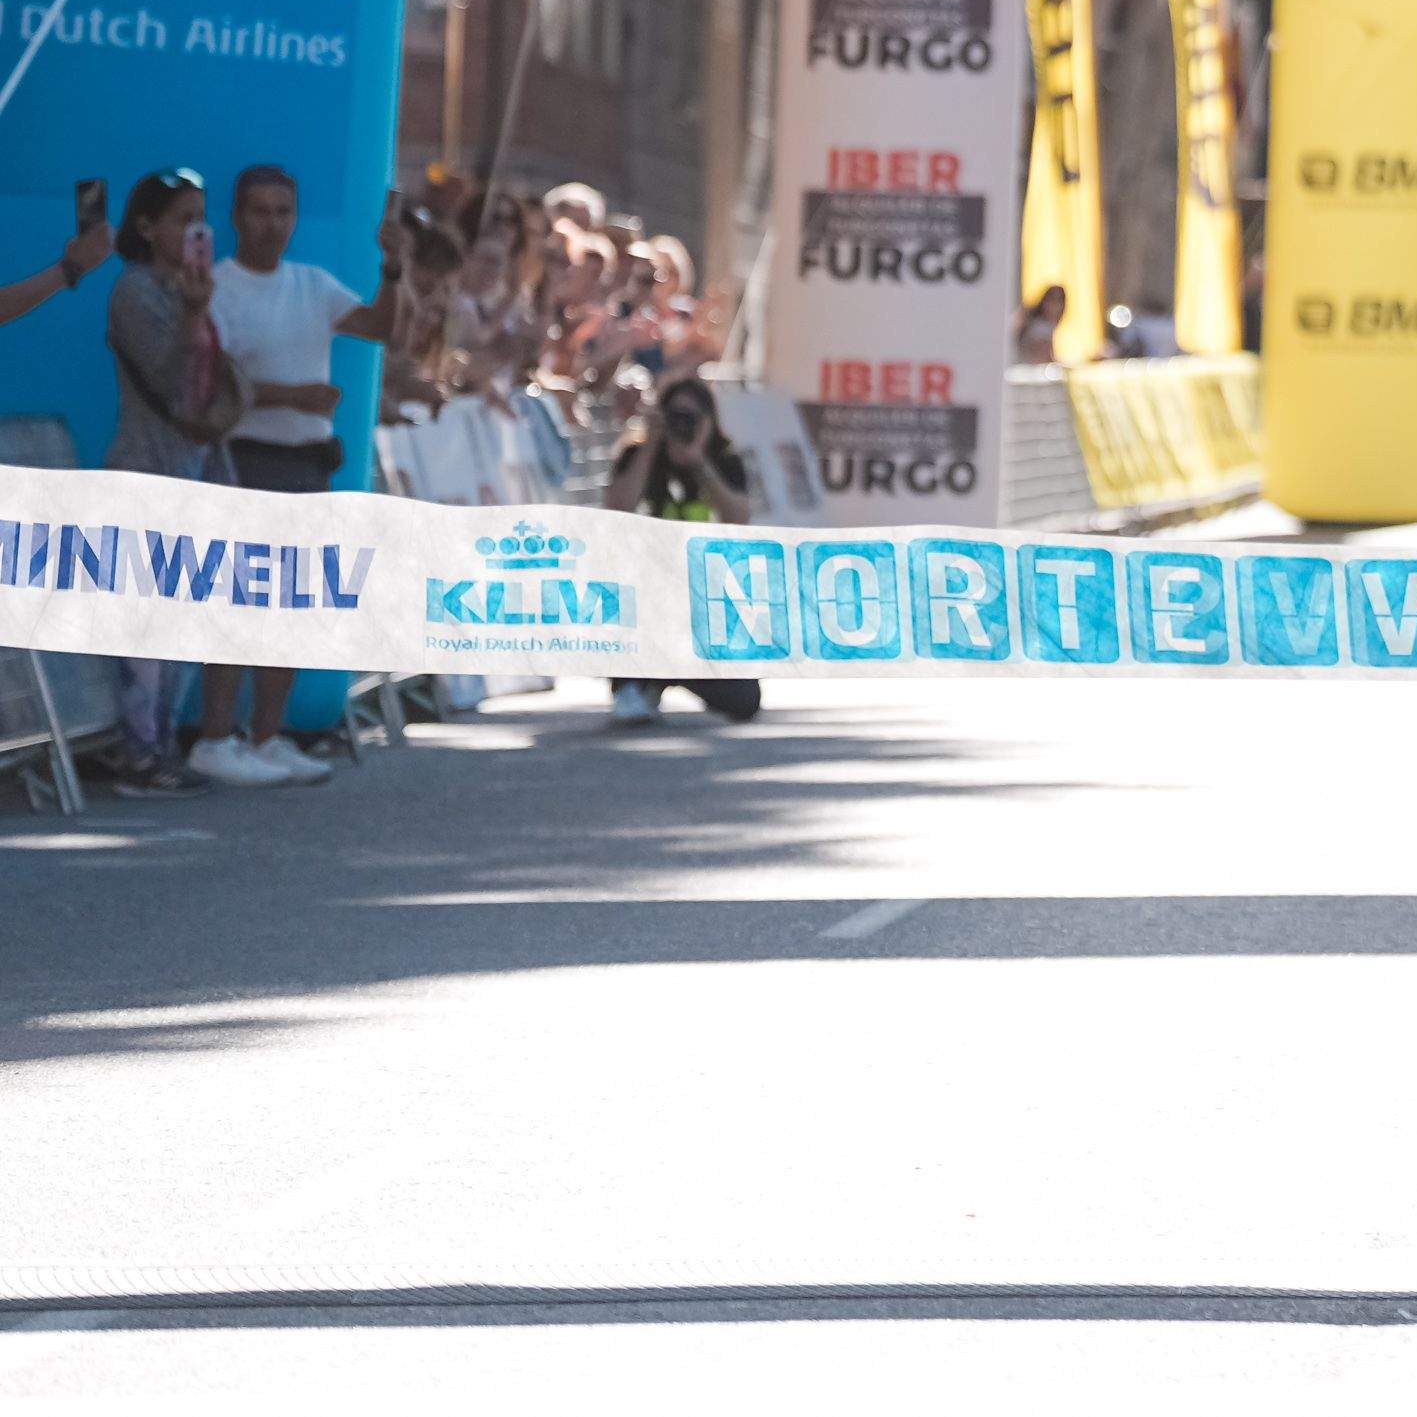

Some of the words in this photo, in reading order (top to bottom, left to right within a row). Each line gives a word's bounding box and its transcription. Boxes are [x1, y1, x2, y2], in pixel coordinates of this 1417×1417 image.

[20, 3, 167, 50] Dutch
[184, 15, 346, 67] Airlines
[807, 31, 993, 73] FURGO
[827, 147, 961, 192] IBER
[820, 359, 955, 404] IBER
[820, 456, 977, 496] URGO
[0, 520, 119, 591] IN
[145, 529, 359, 609] WELL
[426, 577, 620, 625] KLM
[702, 549, 1208, 654] NORTE
[426, 636, 479, 653] Royal
[486, 636, 543, 652] Dutch
[549, 637, 625, 653] Airlines
